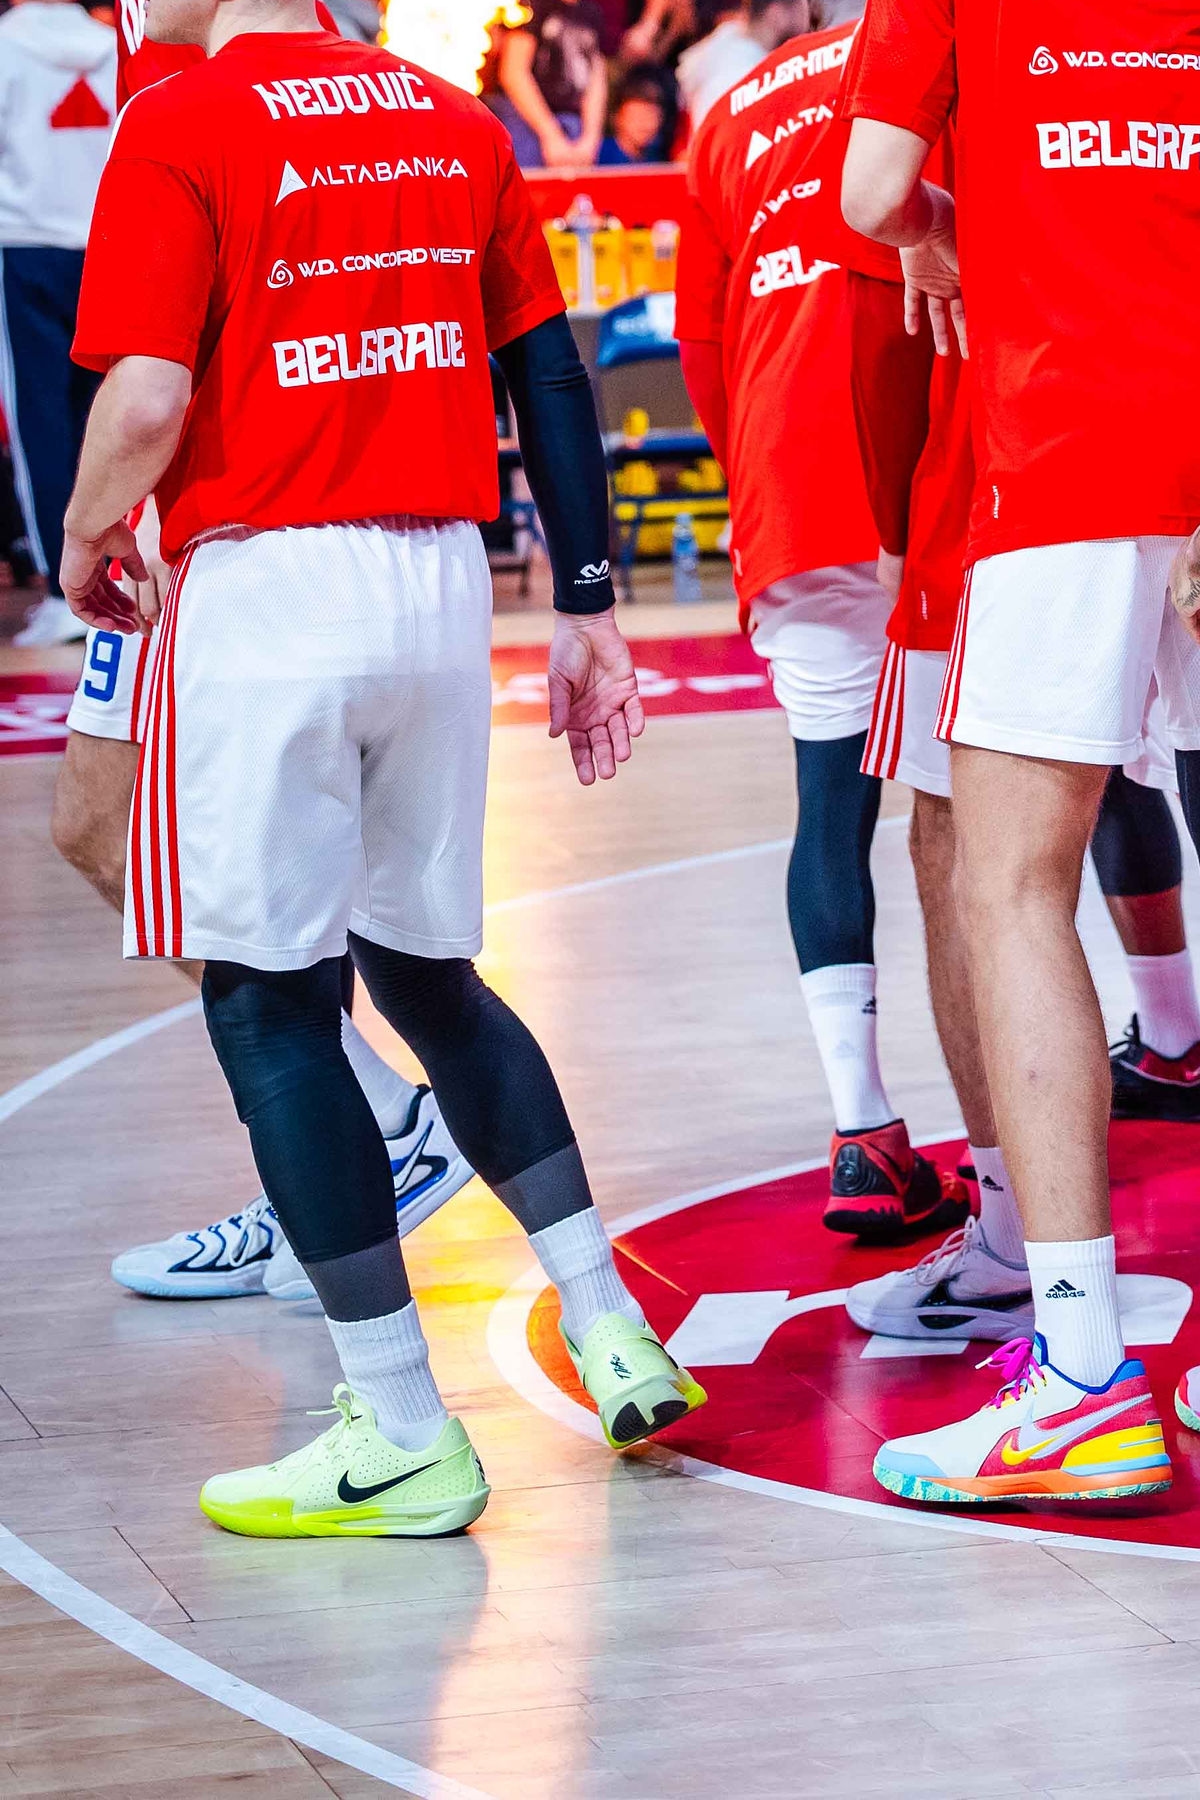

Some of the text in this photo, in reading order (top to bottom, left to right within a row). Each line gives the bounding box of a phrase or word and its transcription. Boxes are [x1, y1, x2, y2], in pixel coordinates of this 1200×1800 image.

[1062, 51, 1108, 67] W.D.
[298, 248, 475, 278] W.D. CONCORD WEST
[272, 321, 466, 388] BELGRADE
[84, 630, 123, 703] 9
[1045, 1290, 1086, 1299] adidas
